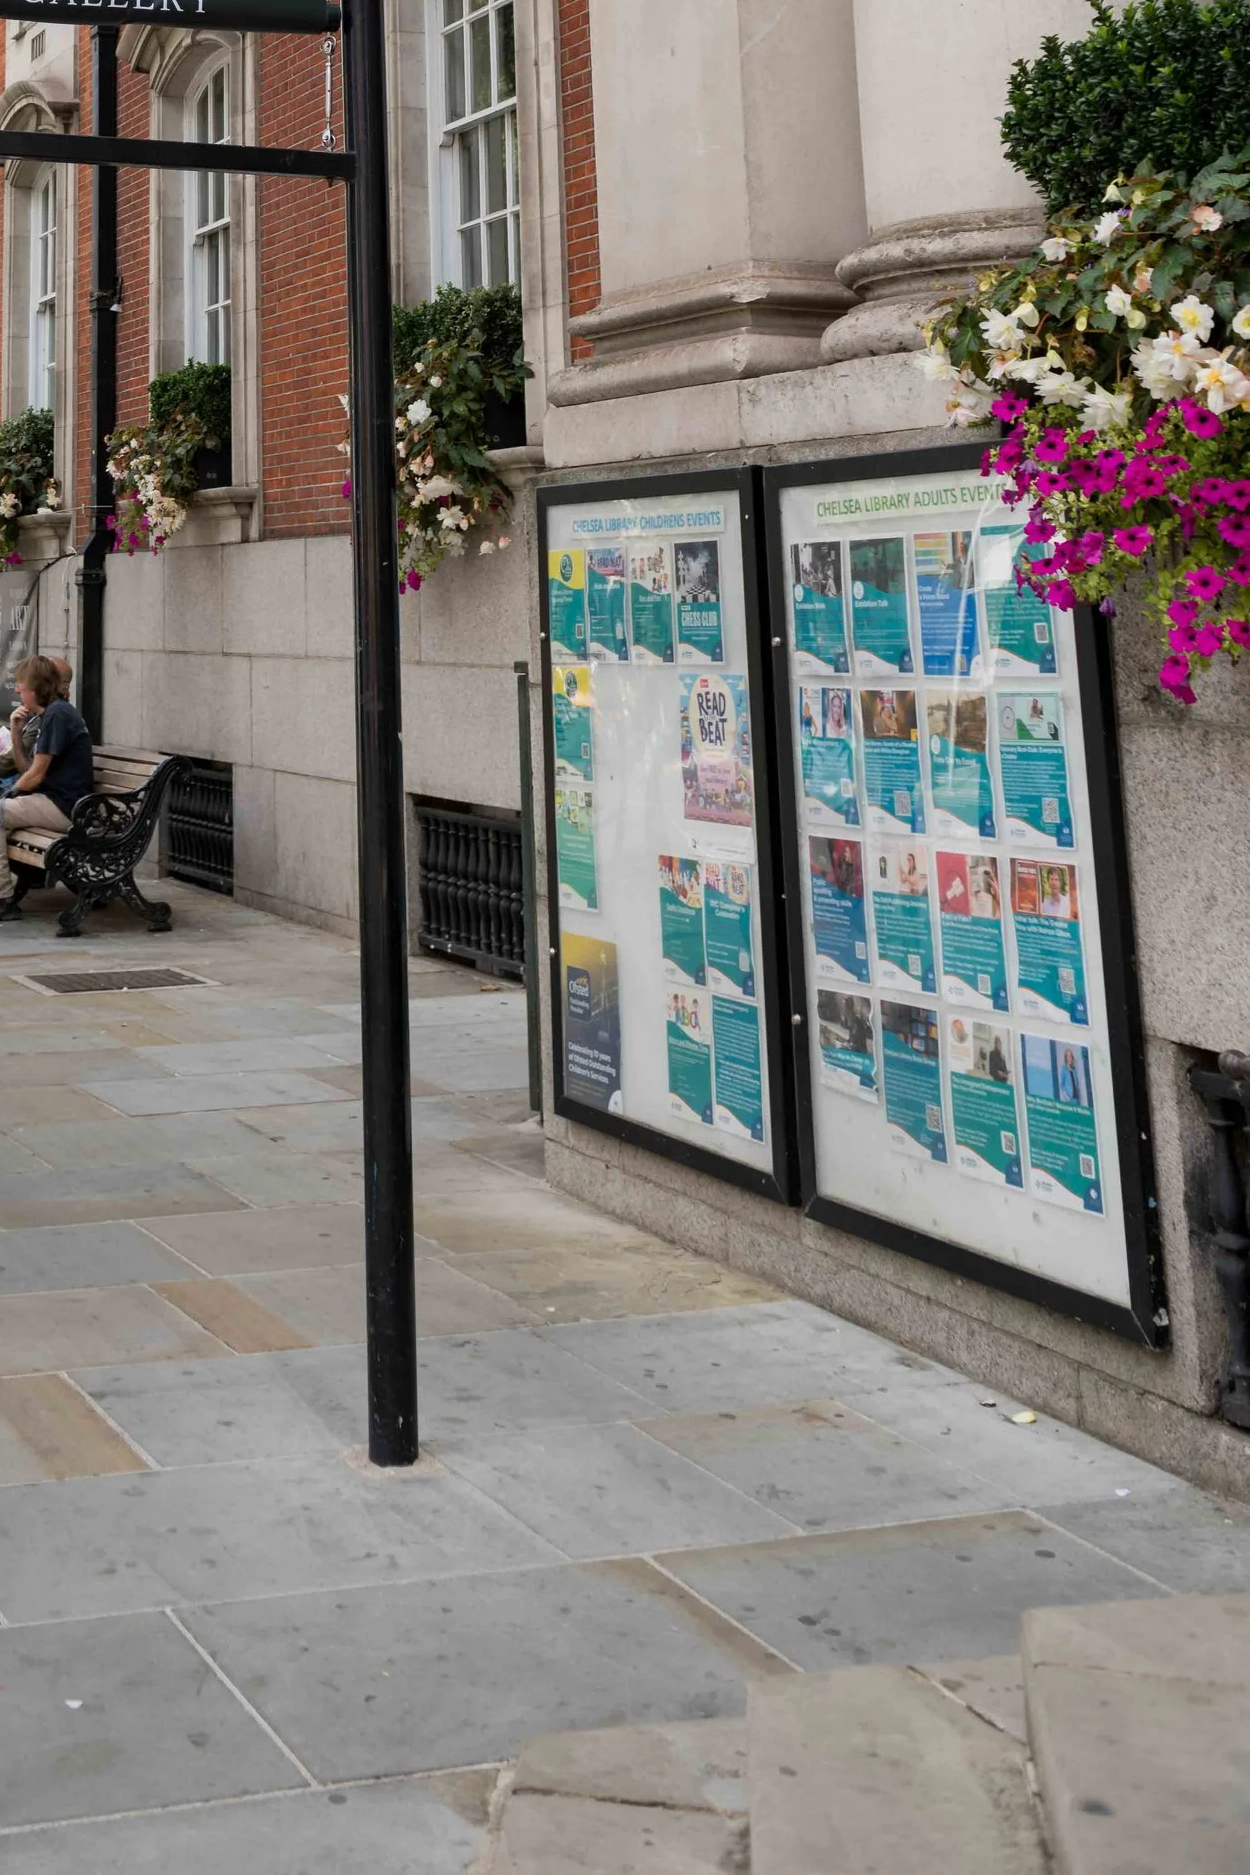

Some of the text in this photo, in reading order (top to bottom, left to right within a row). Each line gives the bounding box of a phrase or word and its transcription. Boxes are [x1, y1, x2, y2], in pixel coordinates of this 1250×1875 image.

[817, 498, 863, 518] CHELSEA
[864, 492, 911, 513] LIBRARY
[913, 488, 958, 508] ADULTS
[572, 510, 721, 533] CHELSEA LIBRARY CHILDRENS EVENTS
[681, 610, 718, 627] CHESS CLUB
[696, 691, 726, 718] READ
[699, 718, 728, 747] BEAT
[568, 980, 590, 997] Ofsted
